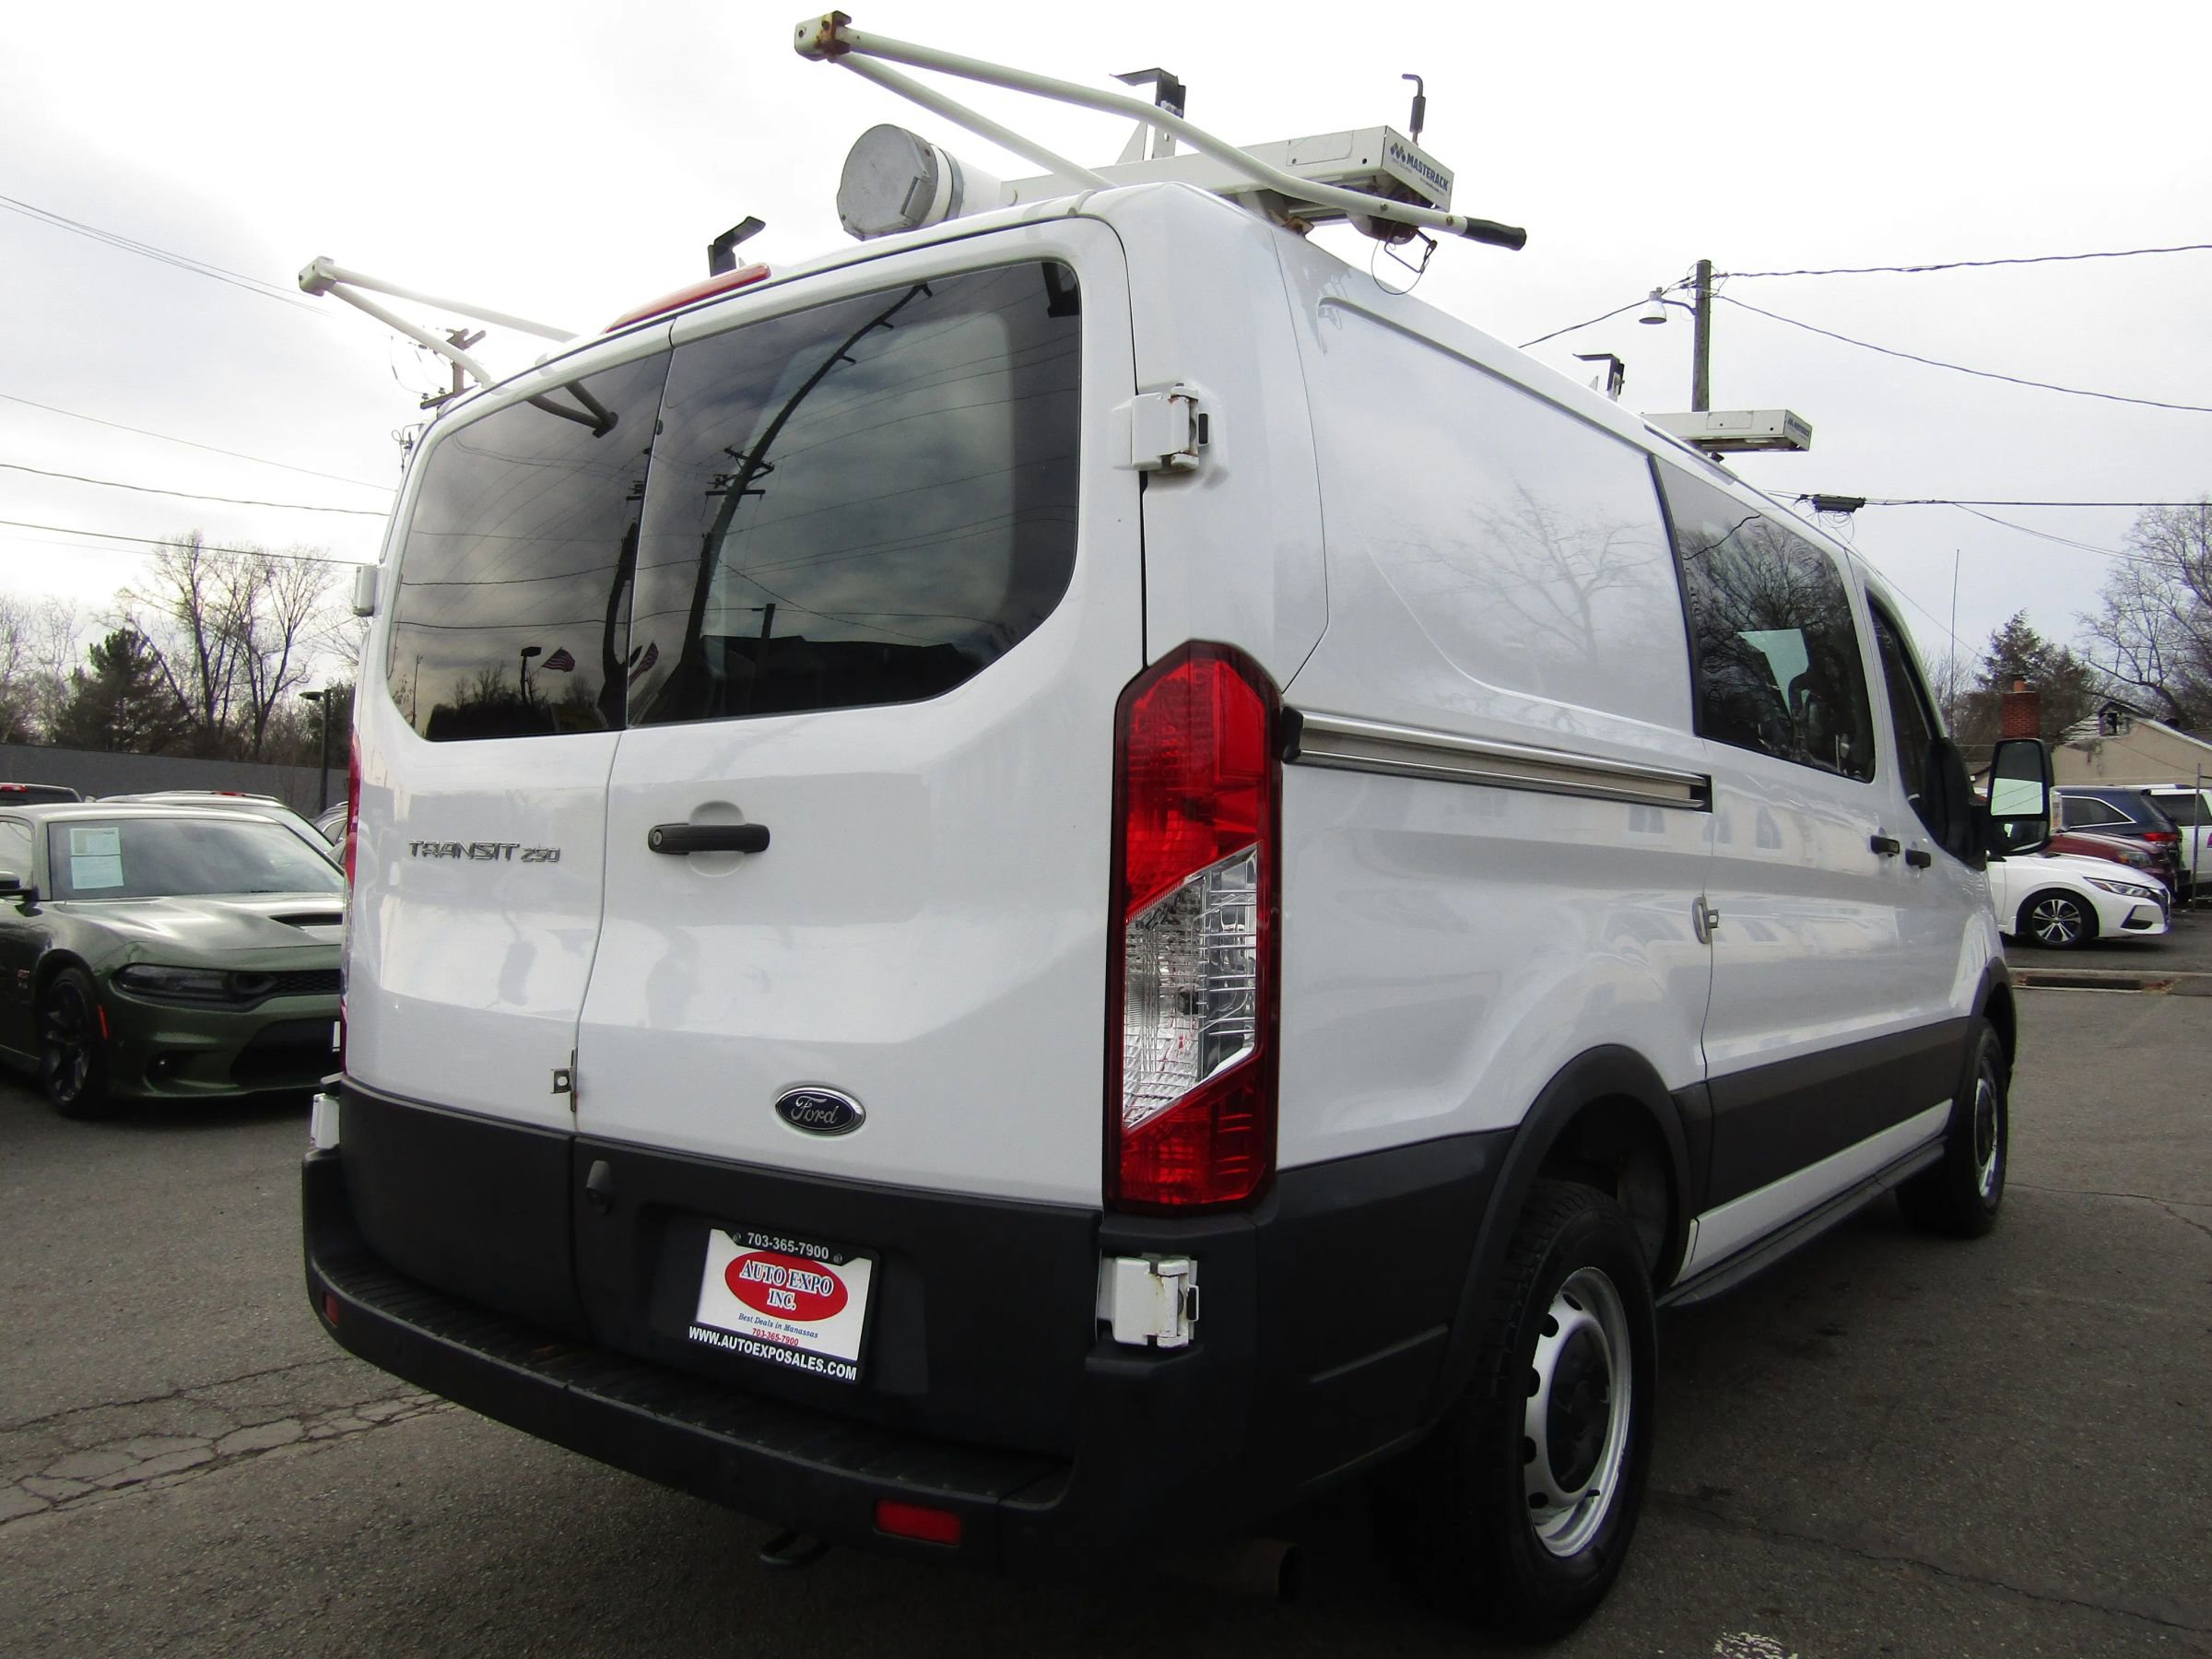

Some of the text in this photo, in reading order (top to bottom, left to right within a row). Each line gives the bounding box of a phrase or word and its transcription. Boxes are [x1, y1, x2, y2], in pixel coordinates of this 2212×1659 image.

[1406, 152, 1449, 192] MASTERACK
[407, 840, 561, 863] TRANSIT 250
[791, 1095, 840, 1124] Ford
[747, 1231, 830, 1260] 703-365-7900
[740, 1260, 834, 1297] AUTO EXPO
[767, 1288, 796, 1311] INC.
[738, 1312, 819, 1339] Best Deals in Manassas
[752, 1327, 799, 1346] 703-365-7900
[688, 1325, 857, 1381] WWW.AUTOEXPOSALES.COM
